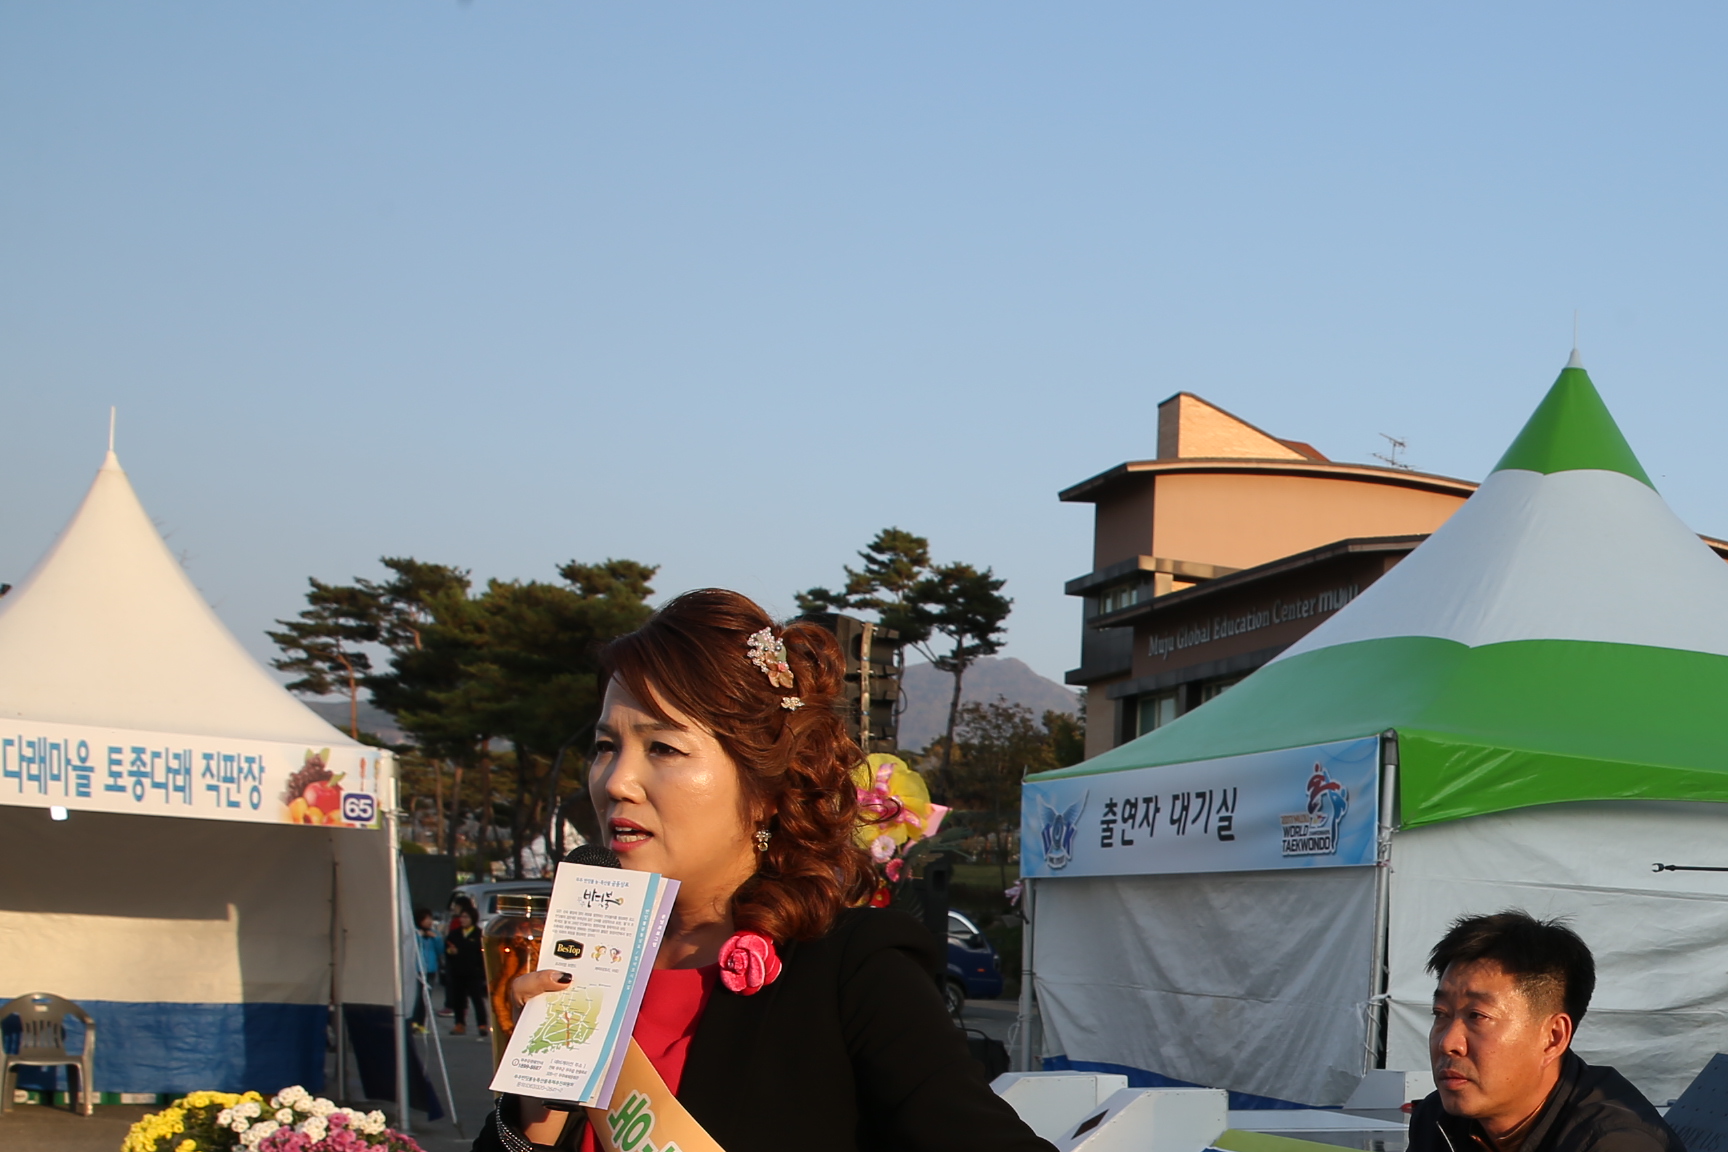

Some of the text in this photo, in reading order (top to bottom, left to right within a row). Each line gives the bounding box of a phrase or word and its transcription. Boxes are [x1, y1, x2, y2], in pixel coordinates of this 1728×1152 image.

[1148, 597, 1316, 660] Muju Global Education Center
[2, 734, 266, 811] 다래마을 토종다래 직판장
[344, 799, 373, 819] 65
[1100, 787, 1237, 848] 출연자 대기실
[1282, 836, 1330, 852] TAEKWONDO
[1283, 825, 1308, 838] WORLD
